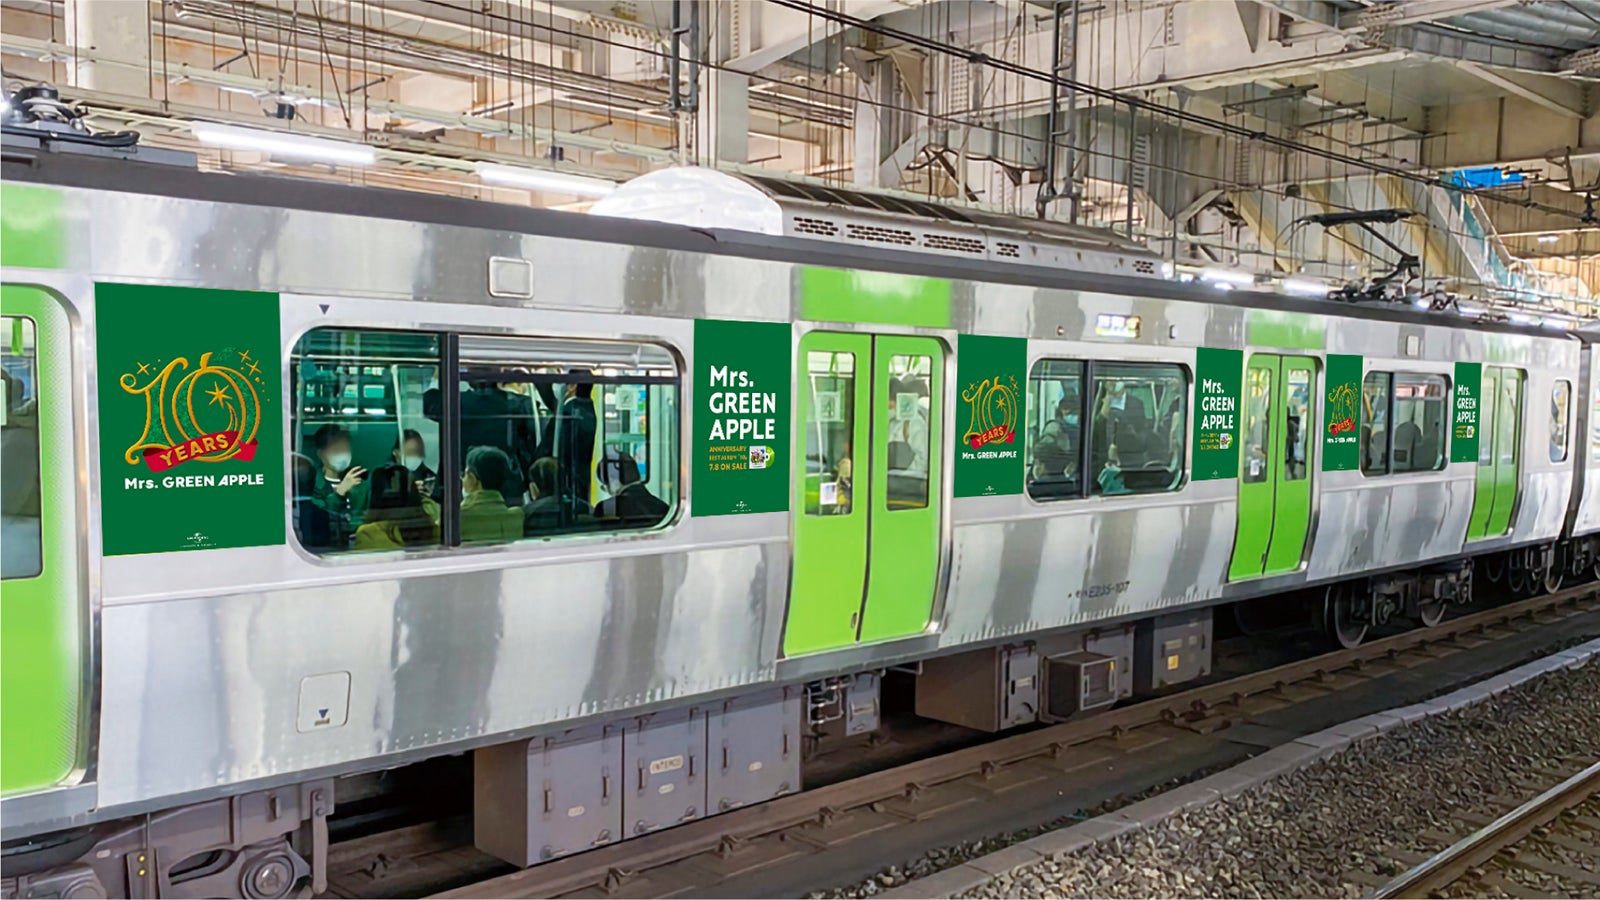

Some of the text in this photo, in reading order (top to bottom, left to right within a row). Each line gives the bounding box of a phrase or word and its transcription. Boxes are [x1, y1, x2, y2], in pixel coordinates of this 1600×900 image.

[709, 365, 754, 387] Mrs.
[1202, 378, 1224, 393] Mrs.
[1457, 384, 1470, 395] Mrs.
[709, 392, 776, 414] GREEN
[1202, 397, 1234, 411] GREEN
[1457, 397, 1476, 409] GREEN
[1200, 414, 1234, 430] APPLE
[1456, 411, 1475, 422] APPLE
[708, 418, 776, 440] APPLE
[976, 426, 1004, 446] YEARS
[159, 433, 230, 467] YEARS
[962, 450, 1017, 460] Mrs. GREEN APPLE
[709, 462, 748, 471] 7.8 ON SALE
[124, 473, 265, 490] Mrs. GREEN APPLE
